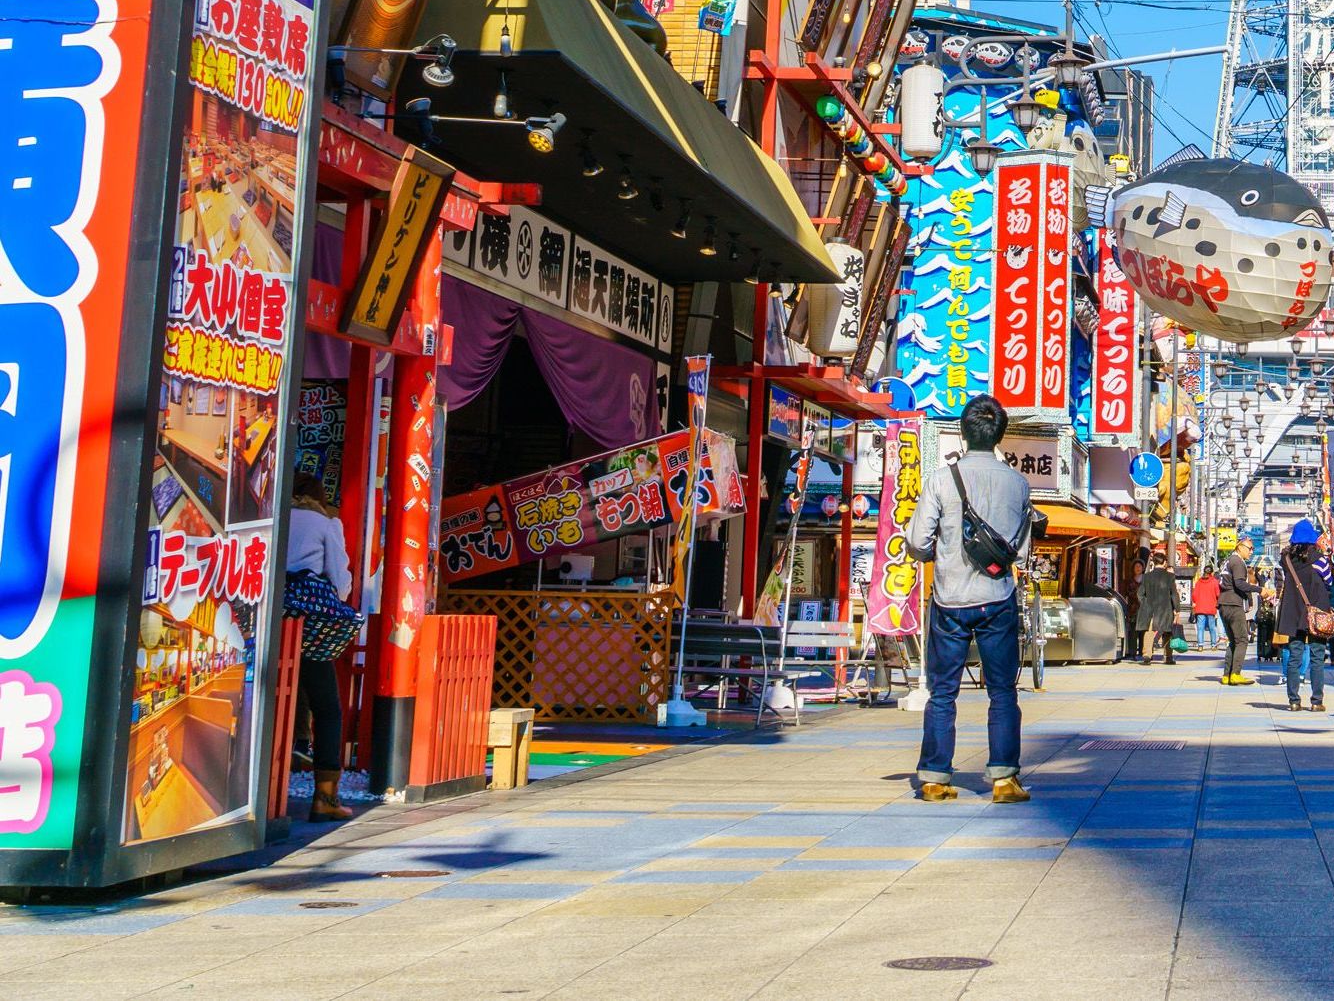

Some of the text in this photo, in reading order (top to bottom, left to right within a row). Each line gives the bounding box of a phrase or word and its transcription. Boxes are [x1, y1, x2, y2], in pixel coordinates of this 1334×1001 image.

[185, 253, 287, 341] 大小個室
[945, 189, 979, 407] 安うて何んでも旨い
[1003, 177, 1033, 396] 名物 てっちり
[1043, 177, 1066, 396] 名物 てっちり
[1122, 247, 1229, 314] づぼらや
[1280, 259, 1318, 331] づぼらや
[163, 321, 285, 394] ご家族連れに最適!!
[1100, 257, 1130, 428] 珍味てっちり
[516, 491, 583, 530] 石焼き
[591, 469, 630, 495] カップ
[595, 480, 666, 532] もつ鍋
[159, 533, 266, 604] テーブル席
[441, 527, 513, 574] おでん
[526, 520, 583, 554] いも
